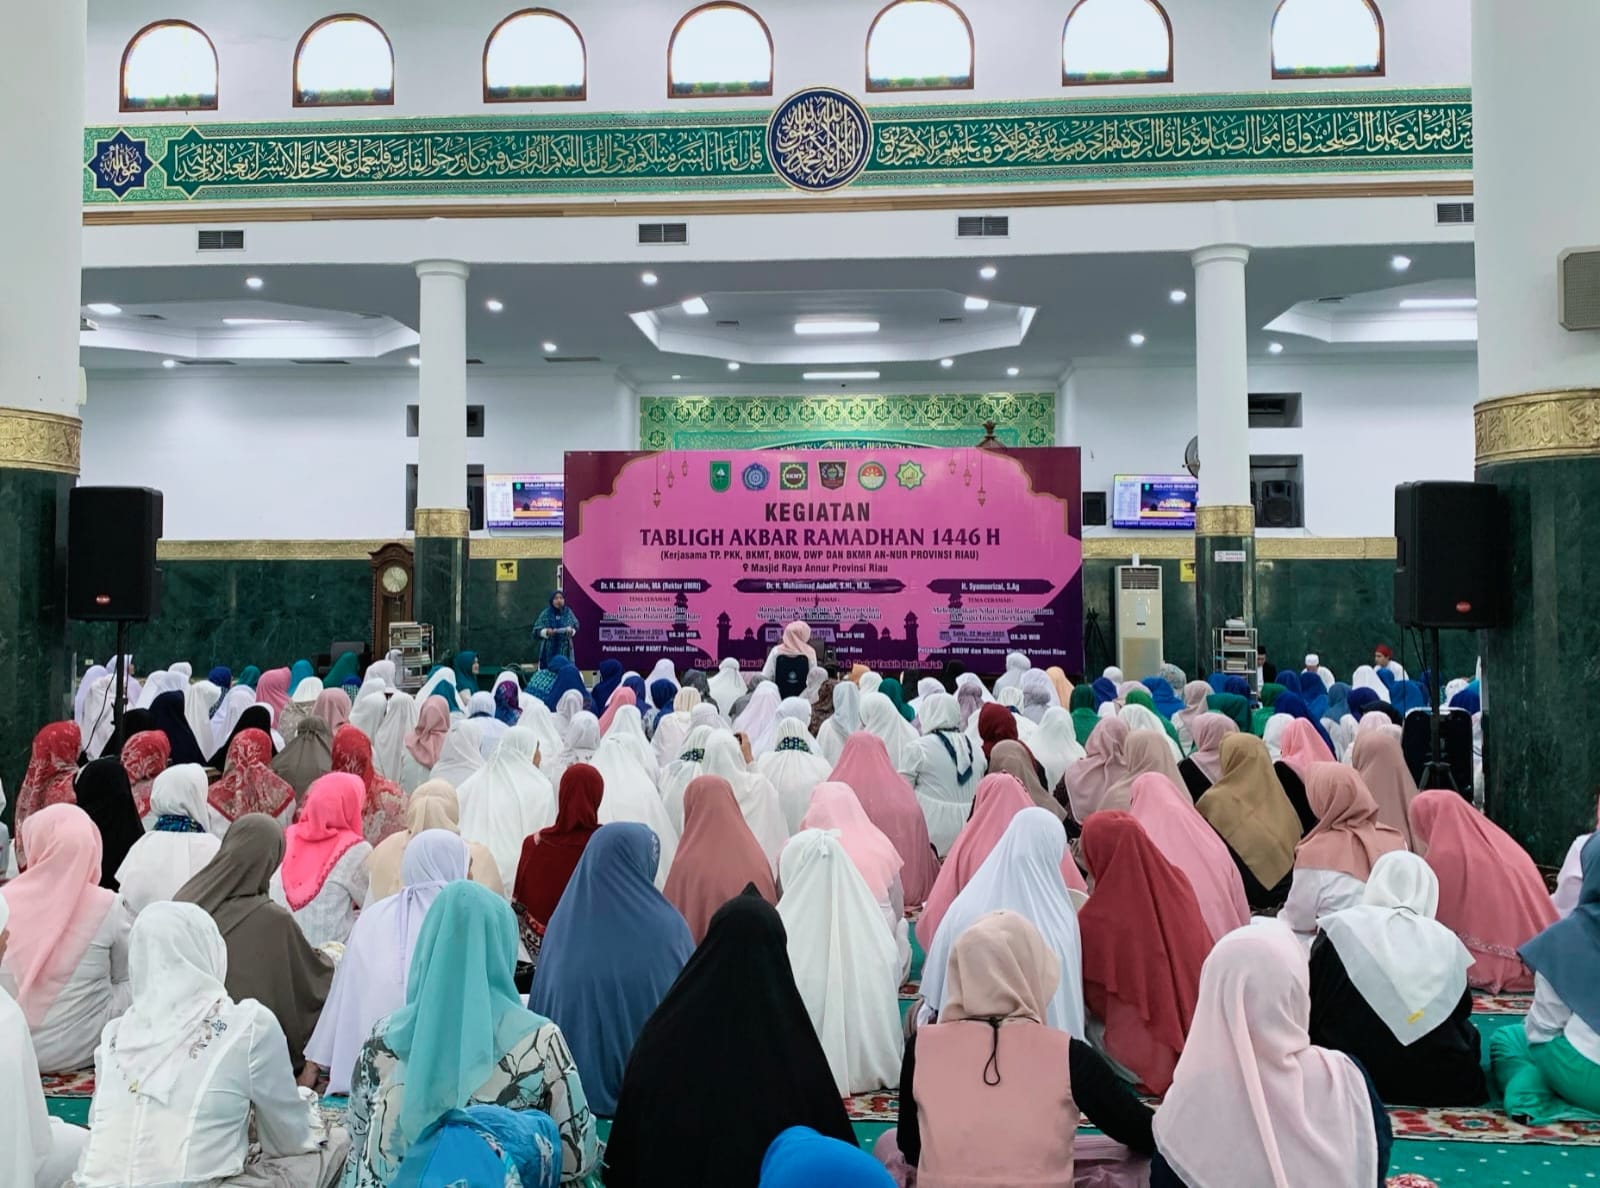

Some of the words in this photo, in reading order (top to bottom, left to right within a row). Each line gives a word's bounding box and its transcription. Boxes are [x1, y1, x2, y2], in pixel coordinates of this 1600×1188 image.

[765, 502, 870, 521] KEGIATAN
[639, 528, 724, 546] TABLIGH
[729, 528, 799, 546] AKBAR
[803, 528, 924, 546] RAMADHAN
[932, 528, 981, 546] 1446
[987, 528, 1001, 546] H
[660, 550, 707, 560] (Kerjasama
[709, 550, 721, 559] TP.
[724, 550, 743, 560] PKK,
[746, 550, 771, 560] BKMT,
[774, 550, 801, 560] BKOW,
[804, 550, 824, 559] DWP
[826, 550, 843, 559] DAN
[846, 550, 872, 559] BKMR
[874, 550, 908, 559] AN-NUR
[911, 550, 952, 559] PROVINSI
[955, 550, 979, 561] RIAU)
[751, 563, 779, 574] Masjid
[782, 563, 802, 574] Raya
[805, 563, 830, 573] Annur
[832, 563, 866, 573] Provinsi
[869, 563, 888, 573] Riau
